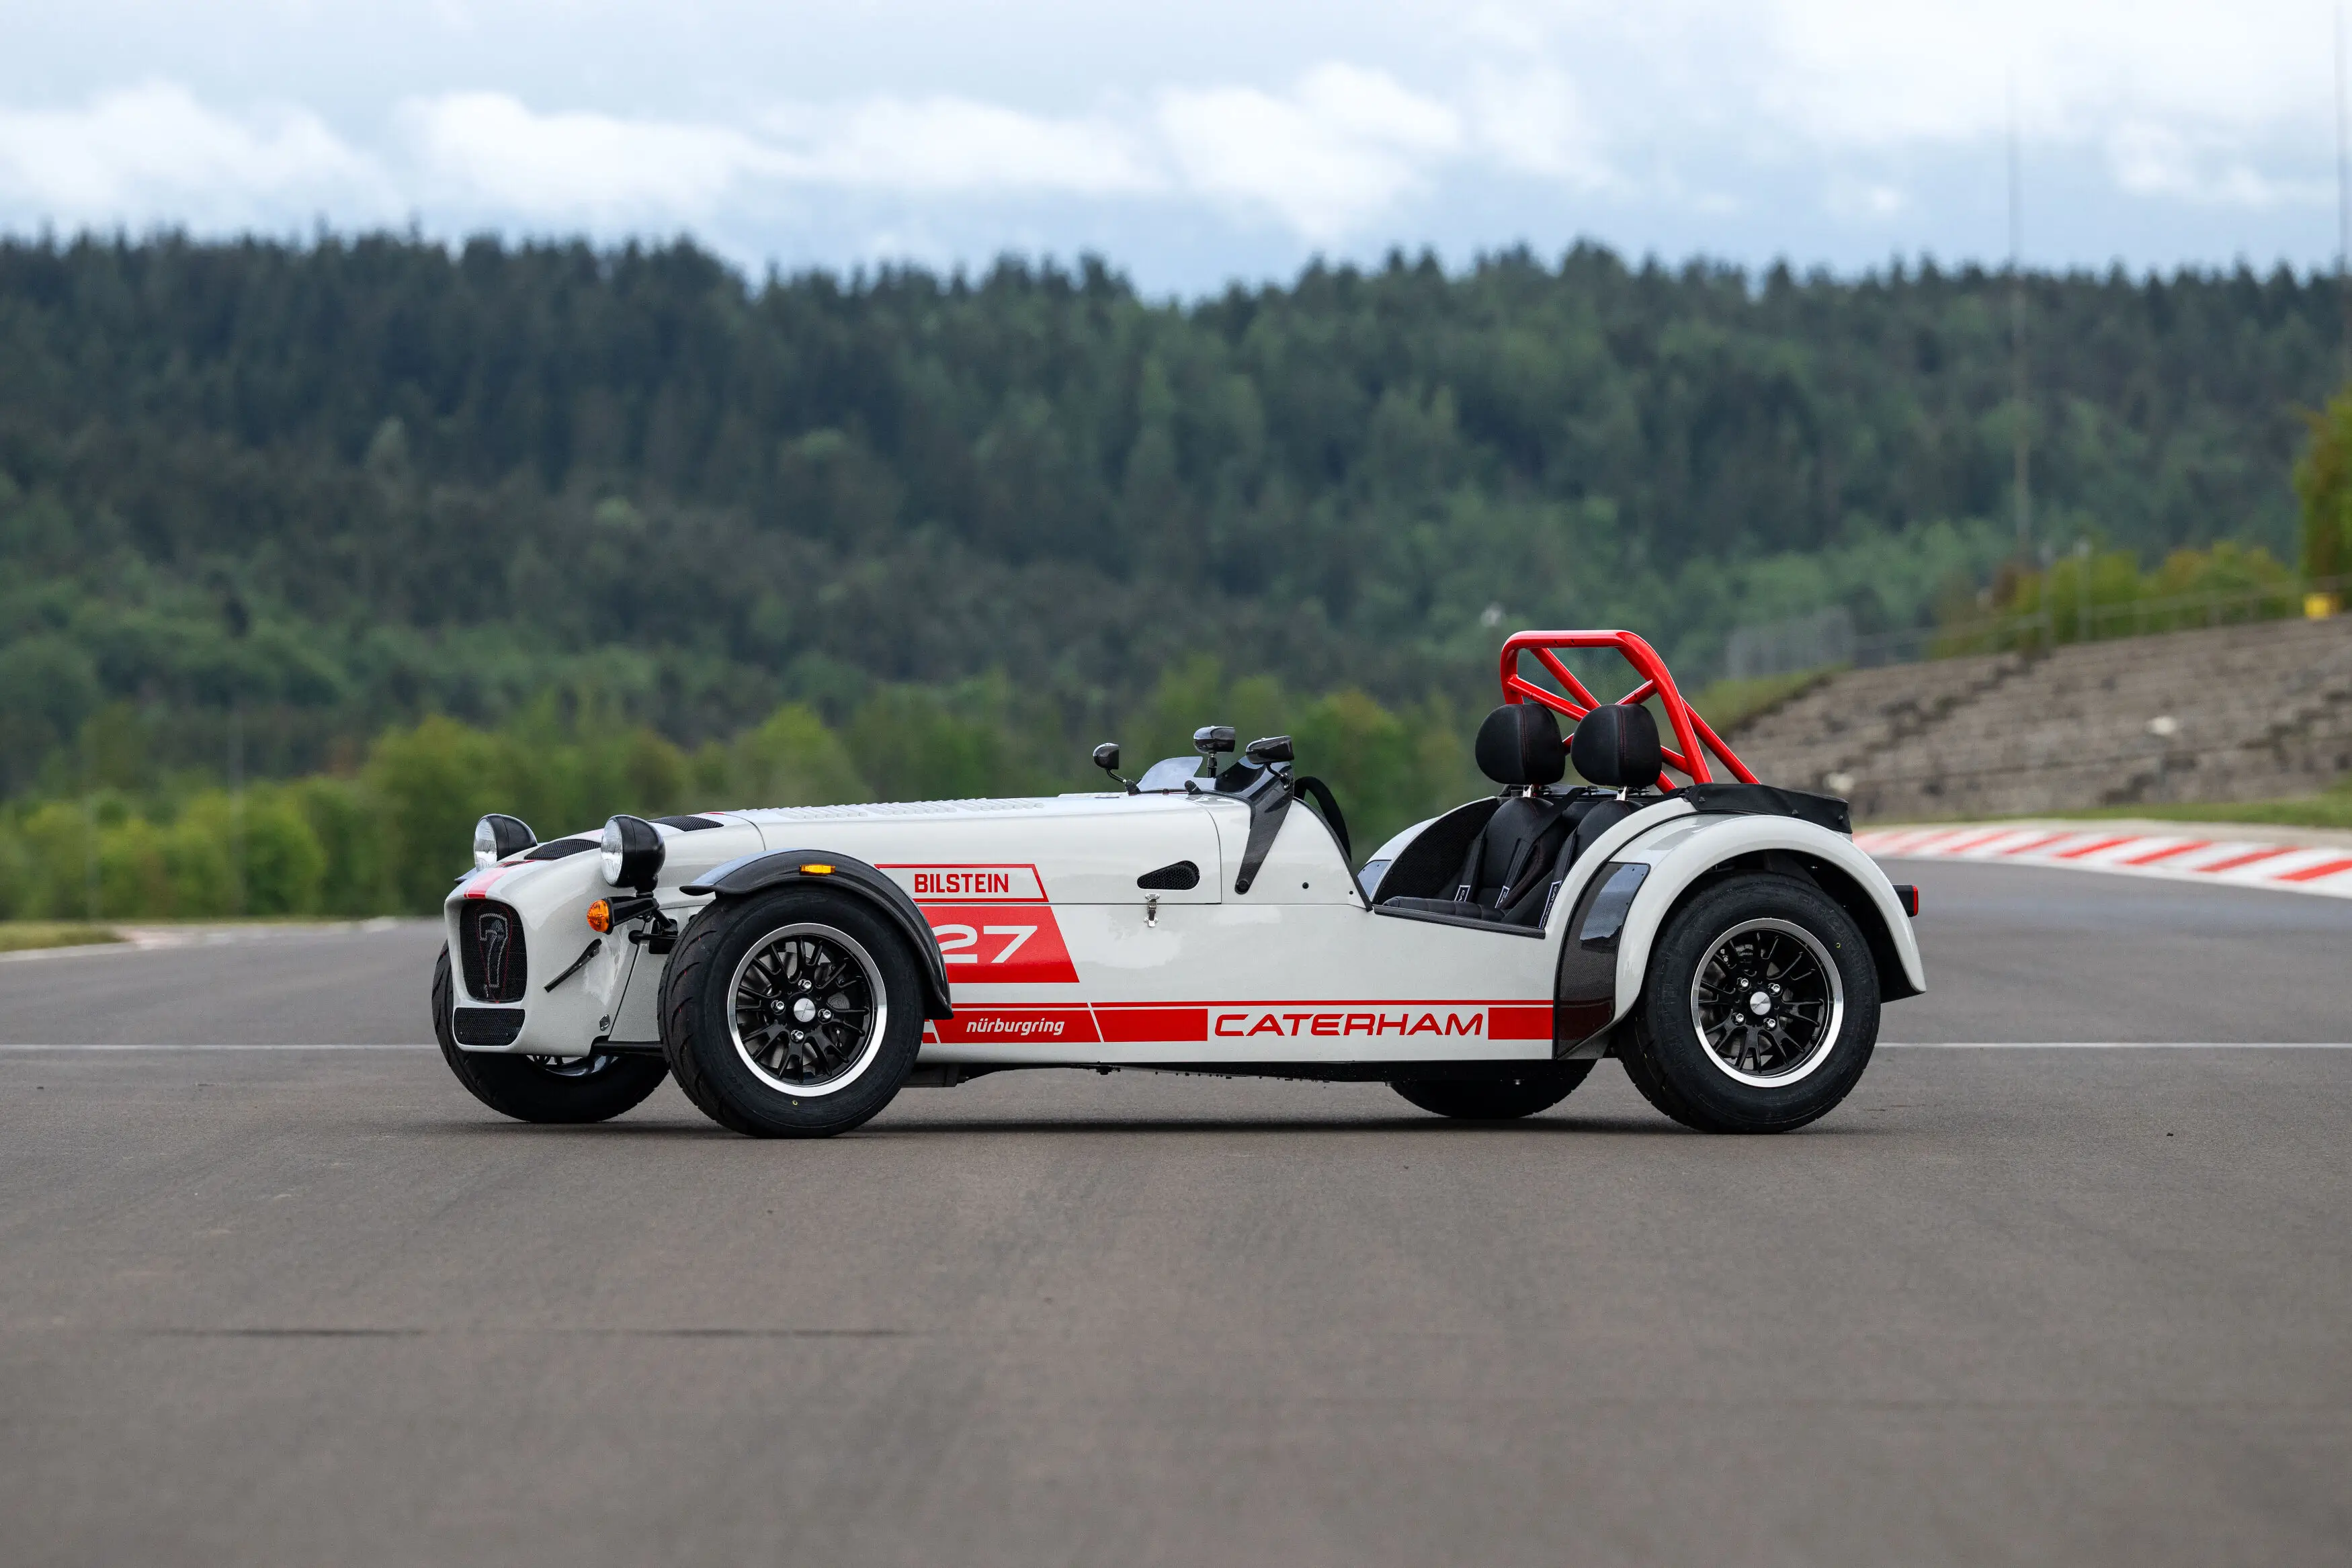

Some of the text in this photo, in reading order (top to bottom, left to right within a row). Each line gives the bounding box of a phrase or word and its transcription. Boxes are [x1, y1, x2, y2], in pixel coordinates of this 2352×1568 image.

[914, 873, 1009, 894] BILSTEIN
[932, 924, 1038, 963] 27
[966, 1017, 1065, 1036] nürburgring
[1214, 1012, 1484, 1037] CATERHAM
